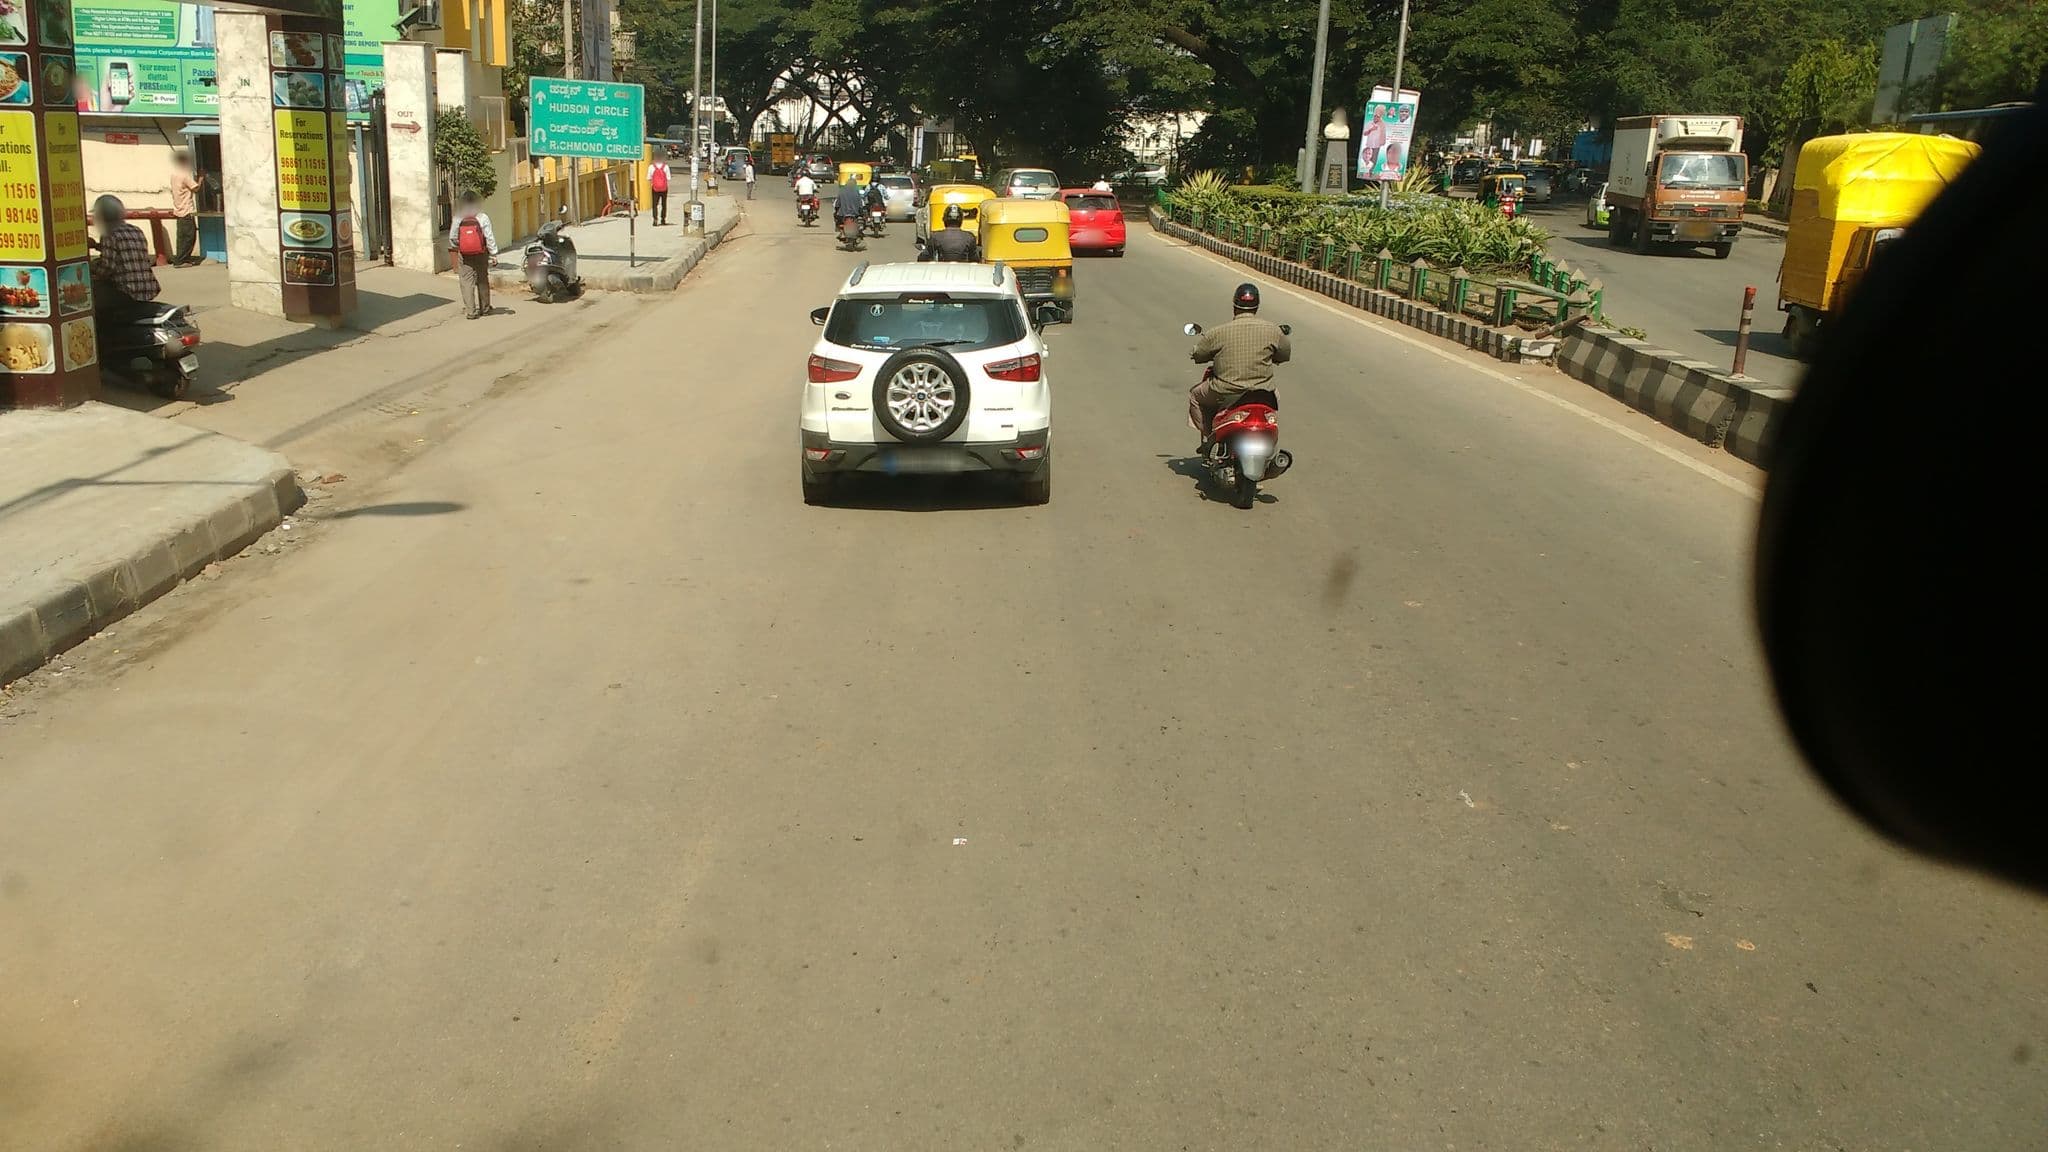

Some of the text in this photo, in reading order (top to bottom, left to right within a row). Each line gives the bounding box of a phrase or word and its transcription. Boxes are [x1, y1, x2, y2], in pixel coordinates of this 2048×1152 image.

[192, 68, 216, 77] Passb
[240, 78, 251, 87] IN
[397, 110, 414, 118] OUT
[549, 103, 630, 116] HUDSON CIRCLE
[295, 118, 306, 127] For
[279, 129, 324, 141] Reservations
[606, 144, 640, 155] CIRCLE
[281, 156, 303, 169] 96861
[282, 173, 328, 187] 96861 98149
[4, 182, 36, 200] 11516
[282, 190, 295, 202] 080
[6, 207, 39, 224] 98149
[17, 232, 40, 250] 5970
